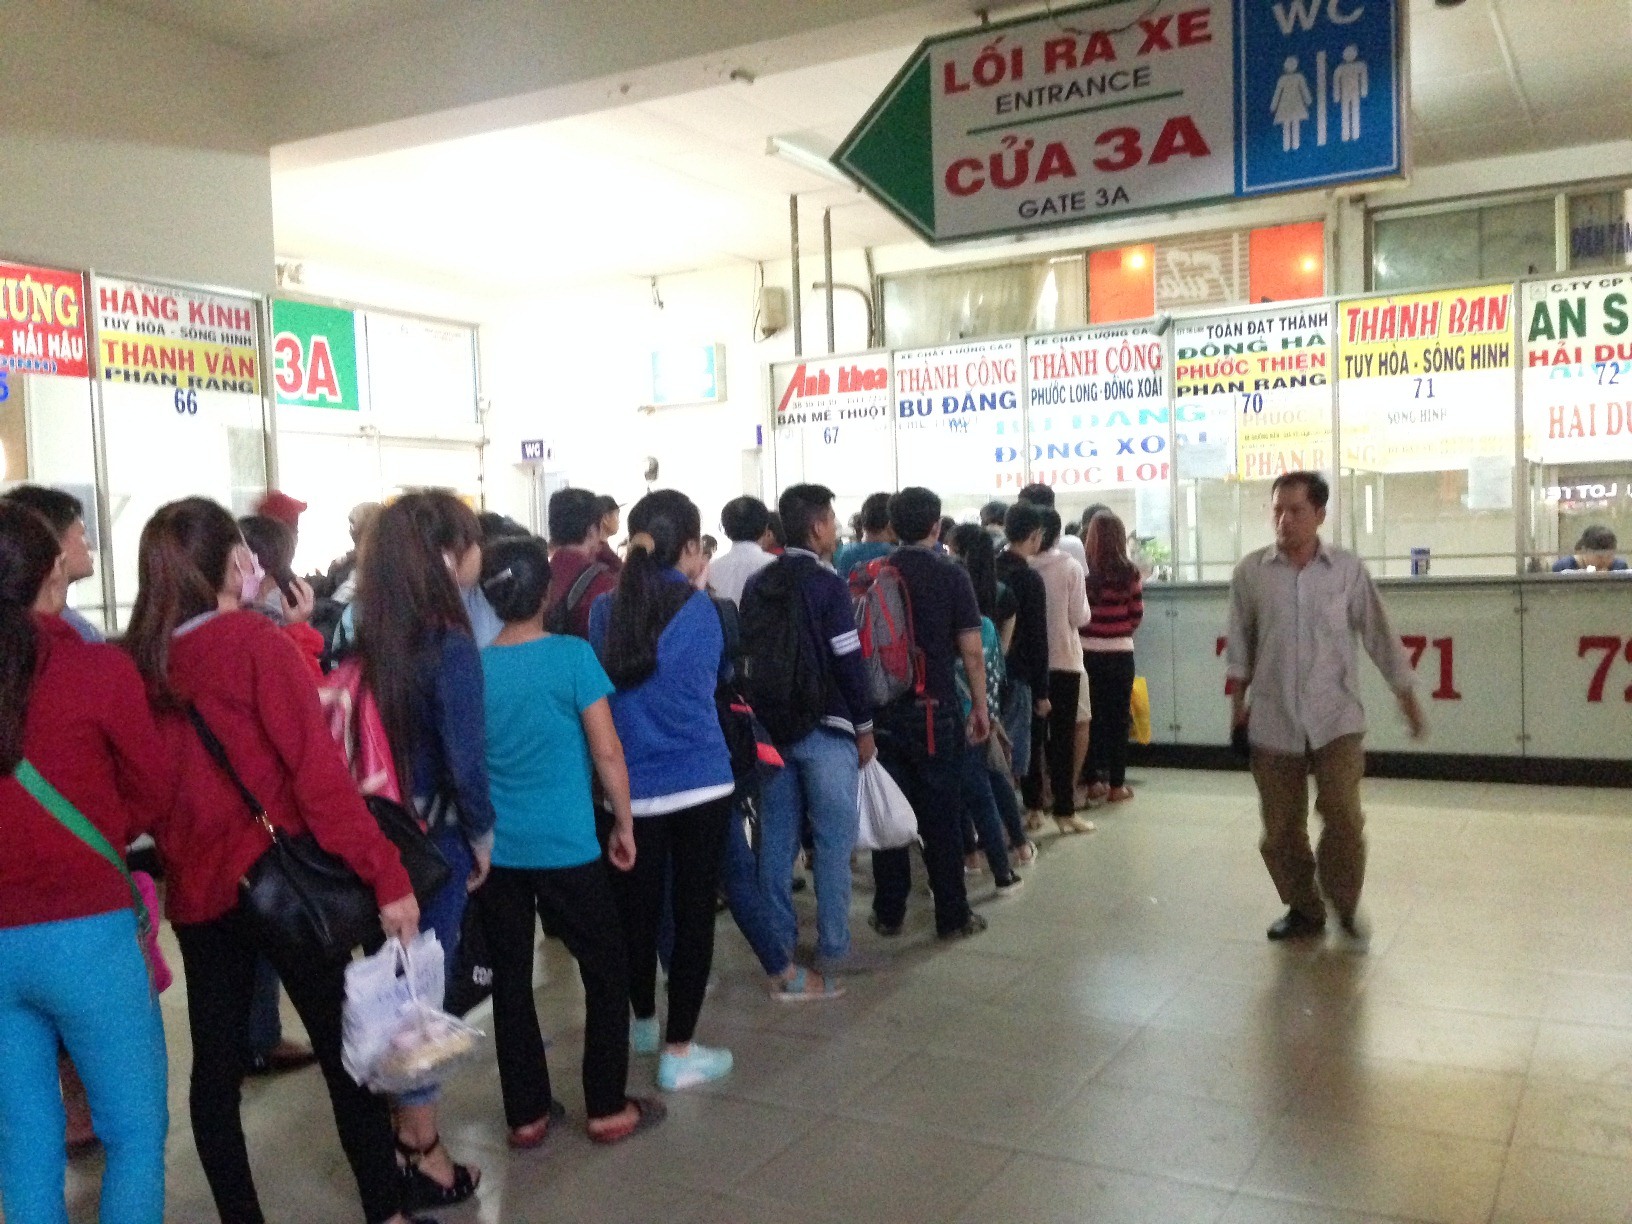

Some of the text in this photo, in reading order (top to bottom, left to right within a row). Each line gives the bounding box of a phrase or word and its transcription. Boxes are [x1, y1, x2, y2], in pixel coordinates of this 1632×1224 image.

[1272, 0, 1365, 36] WC
[944, 8, 1212, 94] LỐI RA XE
[996, 66, 1152, 115] ENTRANCE
[945, 115, 1212, 196] CỬA 3A
[1018, 185, 1130, 218] GATE 3A
[1599, 278, 1623, 288] CP
[102, 316, 130, 329] TUY
[1528, 297, 1586, 342] AN
[1030, 339, 1163, 380] THÀNH CÔNG
[1345, 342, 1509, 378] TUY HÒA SÔNG HINH
[1529, 341, 1582, 367] HẢI
[105, 367, 254, 394] PHAN RANG
[274, 336, 342, 402] 3A
[896, 355, 1017, 393] THÀNH CÔNG
[1176, 356, 1249, 380] PHƯỚC
[1595, 361, 1619, 385] 72
[1031, 380, 1066, 406] PHƯỚC
[1069, 382, 1098, 403] LONG
[1177, 373, 1327, 398] PHAN RANG
[1413, 378, 1435, 398] 71
[174, 387, 198, 415] 66
[1242, 393, 1263, 414] 70
[1549, 403, 1597, 439] HAI
[823, 426, 839, 444] 67
[525, 442, 541, 458] WC
